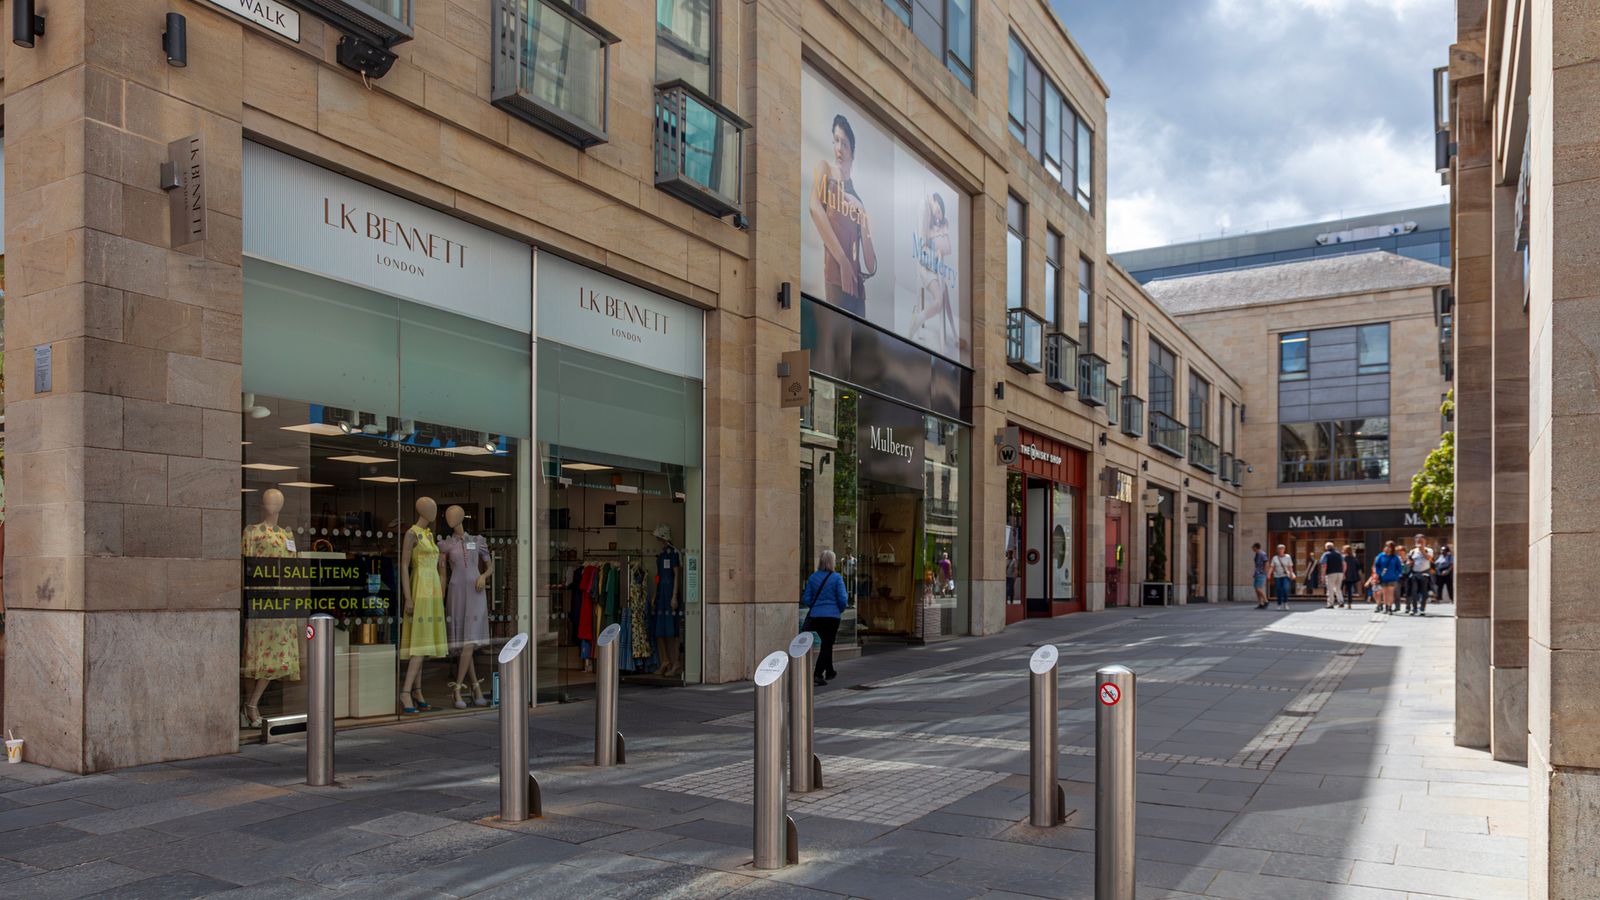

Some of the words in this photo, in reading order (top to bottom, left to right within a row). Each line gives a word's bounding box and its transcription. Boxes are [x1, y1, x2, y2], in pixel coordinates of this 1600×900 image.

[240, 0, 286, 28] WALK
[324, 197, 357, 233] LK
[366, 211, 469, 268] BENNETT
[376, 253, 425, 277] LONDON
[580, 287, 600, 313] LK
[605, 295, 669, 334] BENNETT
[611, 328, 642, 343] LONDON
[870, 425, 914, 463] Mulberry
[1020, 444, 1030, 455] THE
[1031, 444, 1049, 461] WHISKY
[1049, 454, 1062, 465] SHOP
[1002, 449, 1014, 461] W
[1288, 515, 1344, 528] MaxMara
[253, 565, 279, 579] ALL
[284, 566, 317, 579] SALE
[320, 566, 360, 579] ITEMS
[252, 598, 290, 610] HALF
[295, 598, 336, 610] PRICE
[339, 598, 358, 610] OR
[362, 597, 390, 609] LESS
